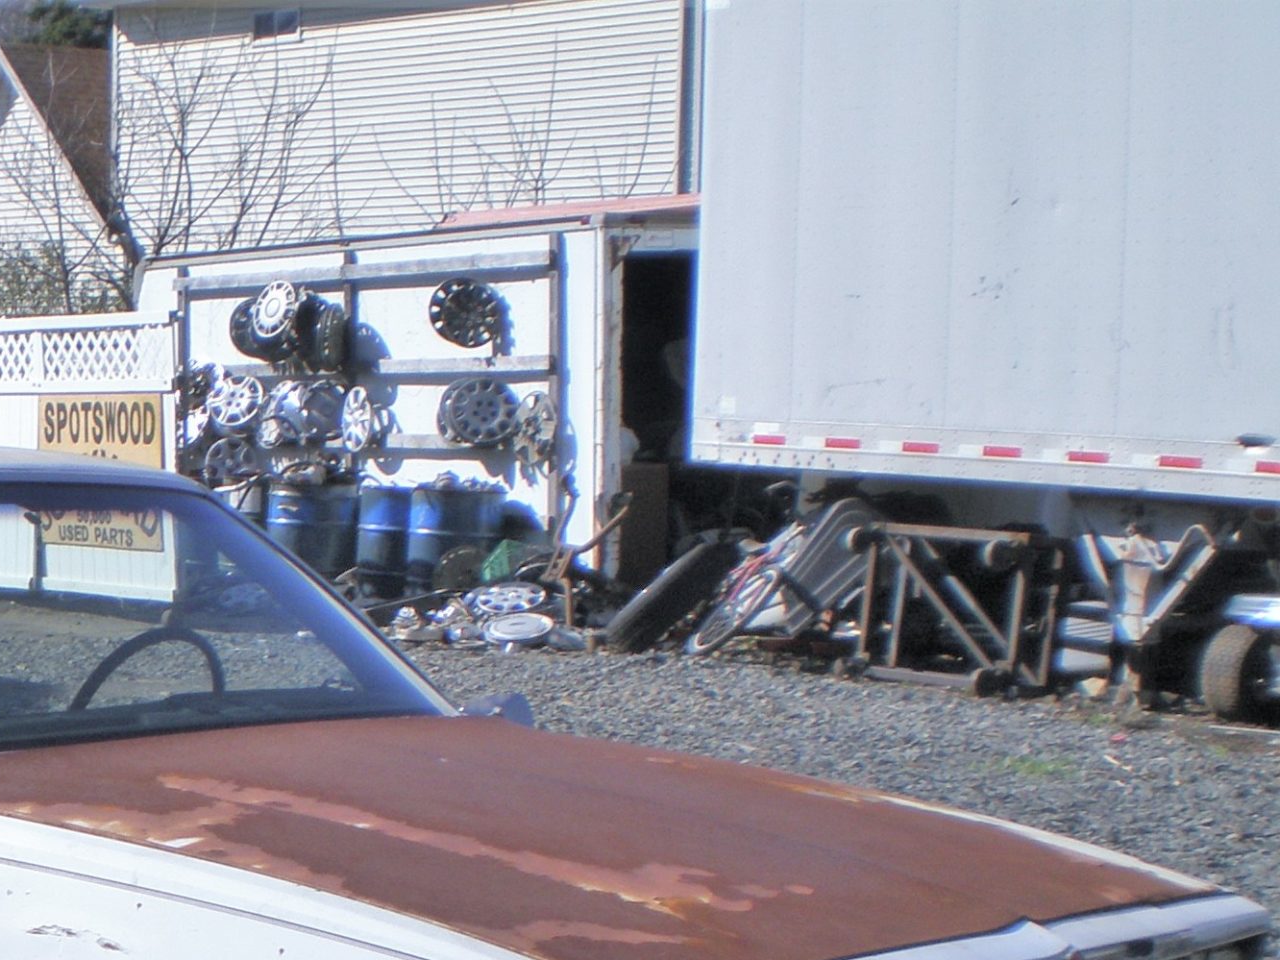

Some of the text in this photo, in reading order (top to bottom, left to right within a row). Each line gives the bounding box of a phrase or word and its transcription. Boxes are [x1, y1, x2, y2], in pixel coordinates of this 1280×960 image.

[44, 401, 155, 445] SPOTSWOOD
[58, 525, 134, 547] USED PARTS
